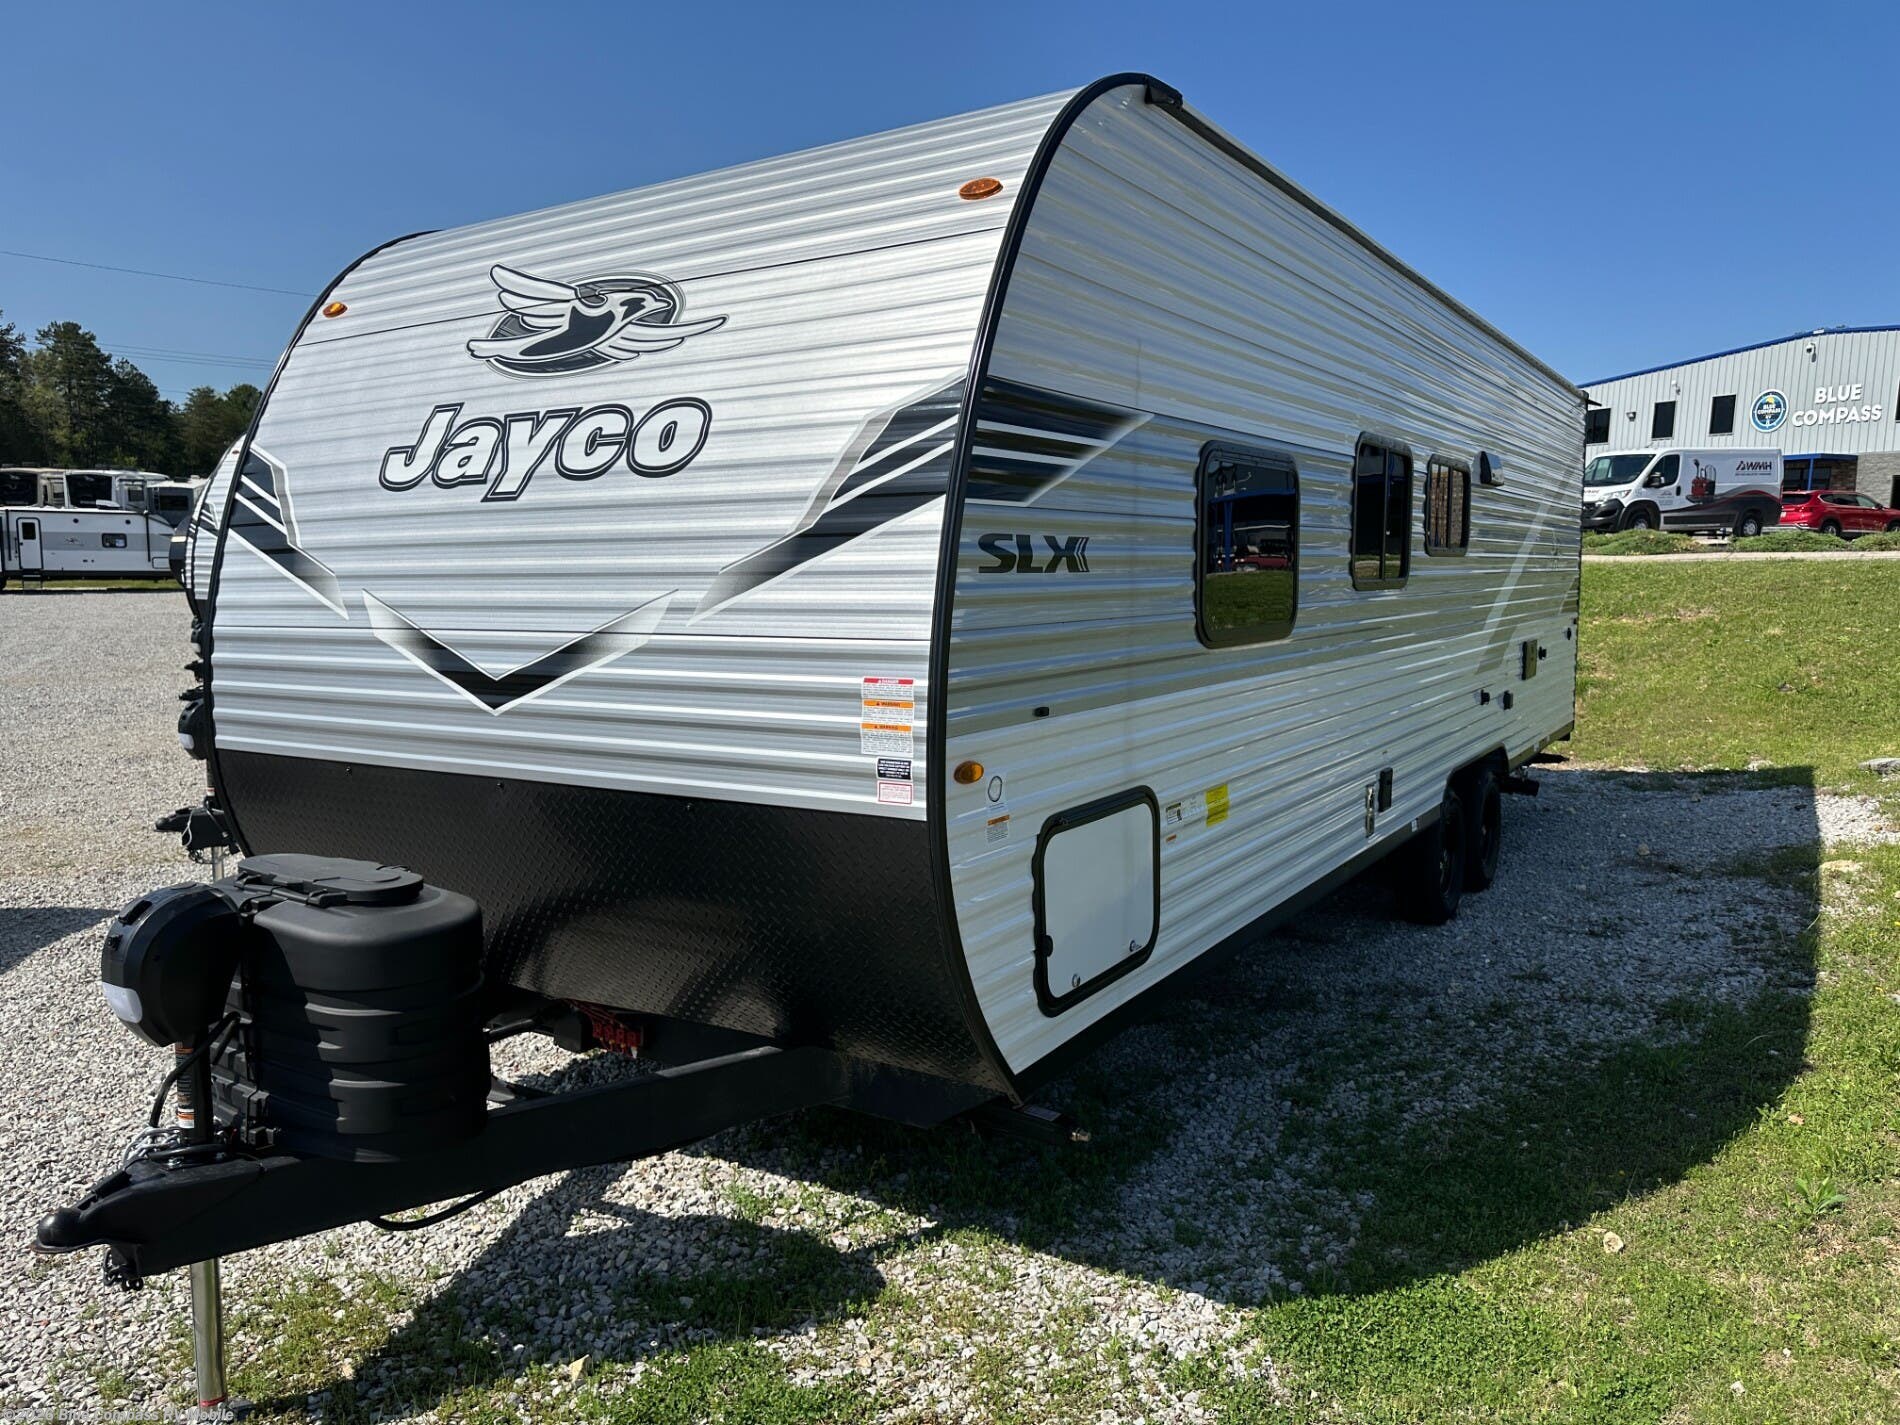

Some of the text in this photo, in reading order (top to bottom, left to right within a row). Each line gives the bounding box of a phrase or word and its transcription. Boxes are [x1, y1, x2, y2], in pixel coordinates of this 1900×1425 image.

[1814, 384, 1862, 404] BLUE
[1792, 405, 1882, 427] COMPASS
[378, 397, 713, 502] Jayco
[978, 533, 1090, 573] SLX
